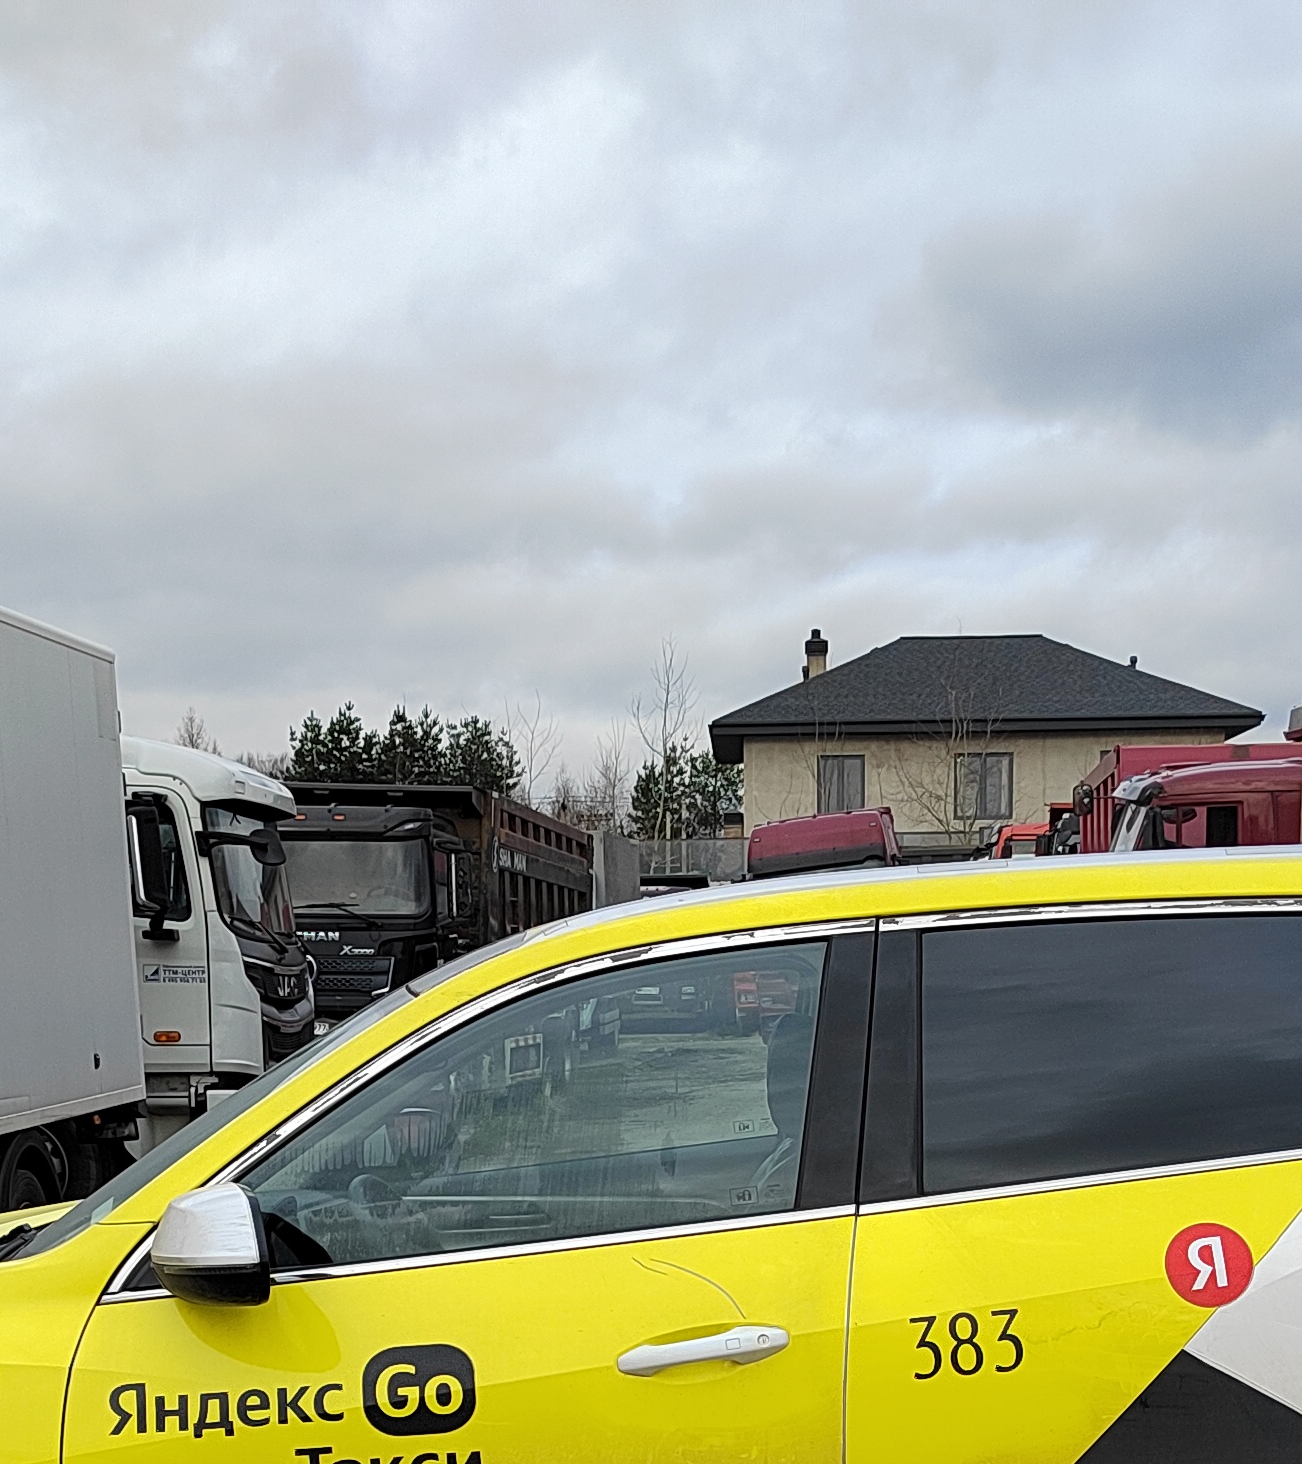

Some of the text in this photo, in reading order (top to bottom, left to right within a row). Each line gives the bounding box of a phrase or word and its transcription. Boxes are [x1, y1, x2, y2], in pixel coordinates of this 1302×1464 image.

[1187, 1236, 1229, 1291] Я
[909, 1308, 1025, 1380] 383
[108, 1363, 465, 1439] Яндекс Go
